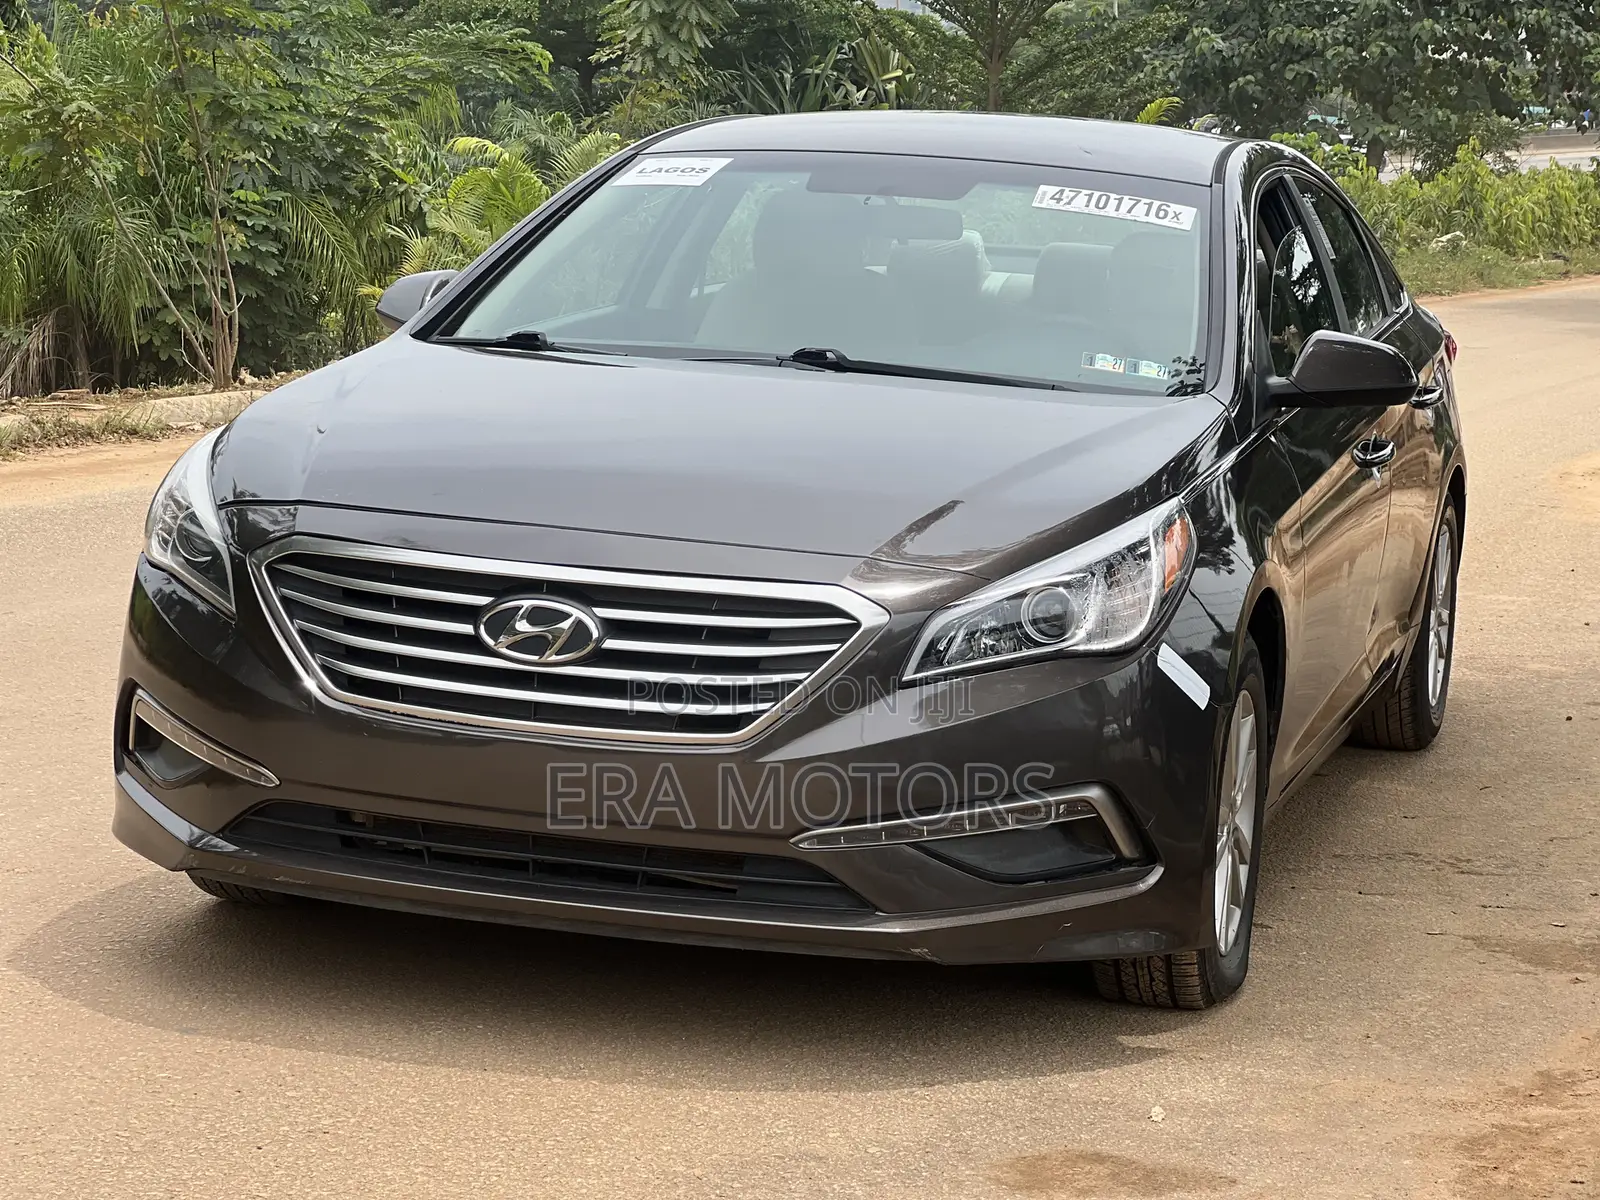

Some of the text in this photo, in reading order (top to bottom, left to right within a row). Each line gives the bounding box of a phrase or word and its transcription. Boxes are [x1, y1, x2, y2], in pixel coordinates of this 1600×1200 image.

[637, 166, 711, 174] LAGOS
[1112, 357, 1123, 371] 27
[1156, 364, 1168, 379] 27
